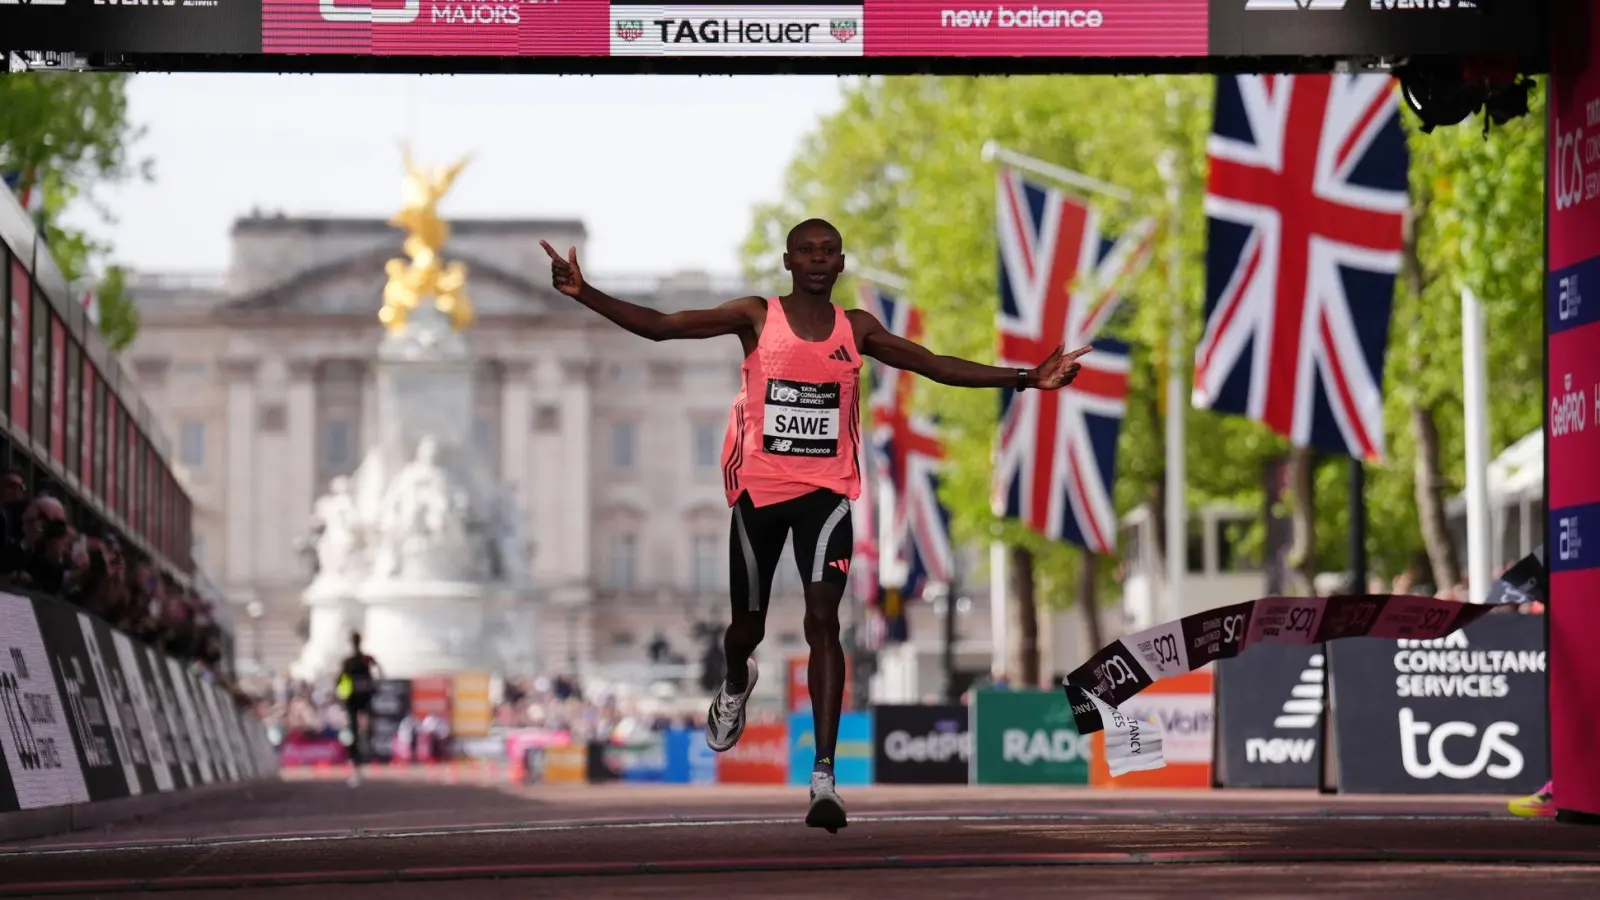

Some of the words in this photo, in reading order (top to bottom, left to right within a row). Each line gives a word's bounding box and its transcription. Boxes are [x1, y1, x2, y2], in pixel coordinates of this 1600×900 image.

[431, 4, 521, 24] MAJORS
[940, 9, 992, 27] new
[998, 6, 1104, 28] balance
[771, 383, 799, 403] tcs
[775, 414, 828, 435] SAWE
[1551, 386, 1586, 438] GetPRO
[805, 446, 831, 454] balance
[1223, 612, 1246, 645] cs
[1101, 654, 1139, 690] tcs
[1395, 674, 1509, 698] SERVICES
[1126, 717, 1141, 755] TANCY
[1398, 706, 1525, 780] tcs
[1245, 737, 1317, 764] new
